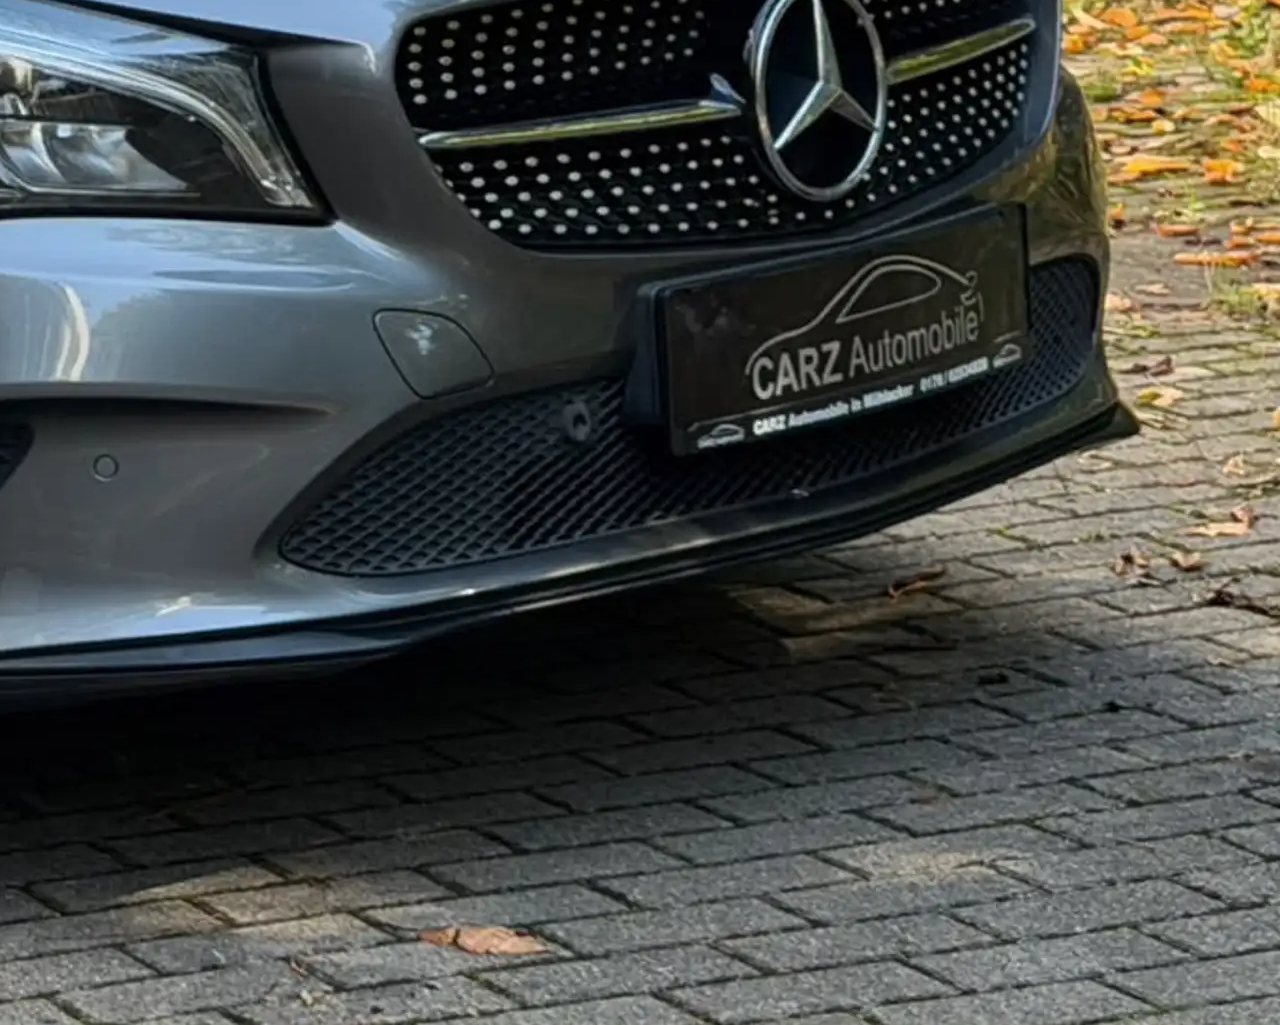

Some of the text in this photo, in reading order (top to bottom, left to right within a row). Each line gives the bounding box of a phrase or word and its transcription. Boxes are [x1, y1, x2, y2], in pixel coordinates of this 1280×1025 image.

[752, 340, 843, 401] CARZ
[848, 305, 980, 378] Automobile
[753, 414, 787, 436] CARZ
